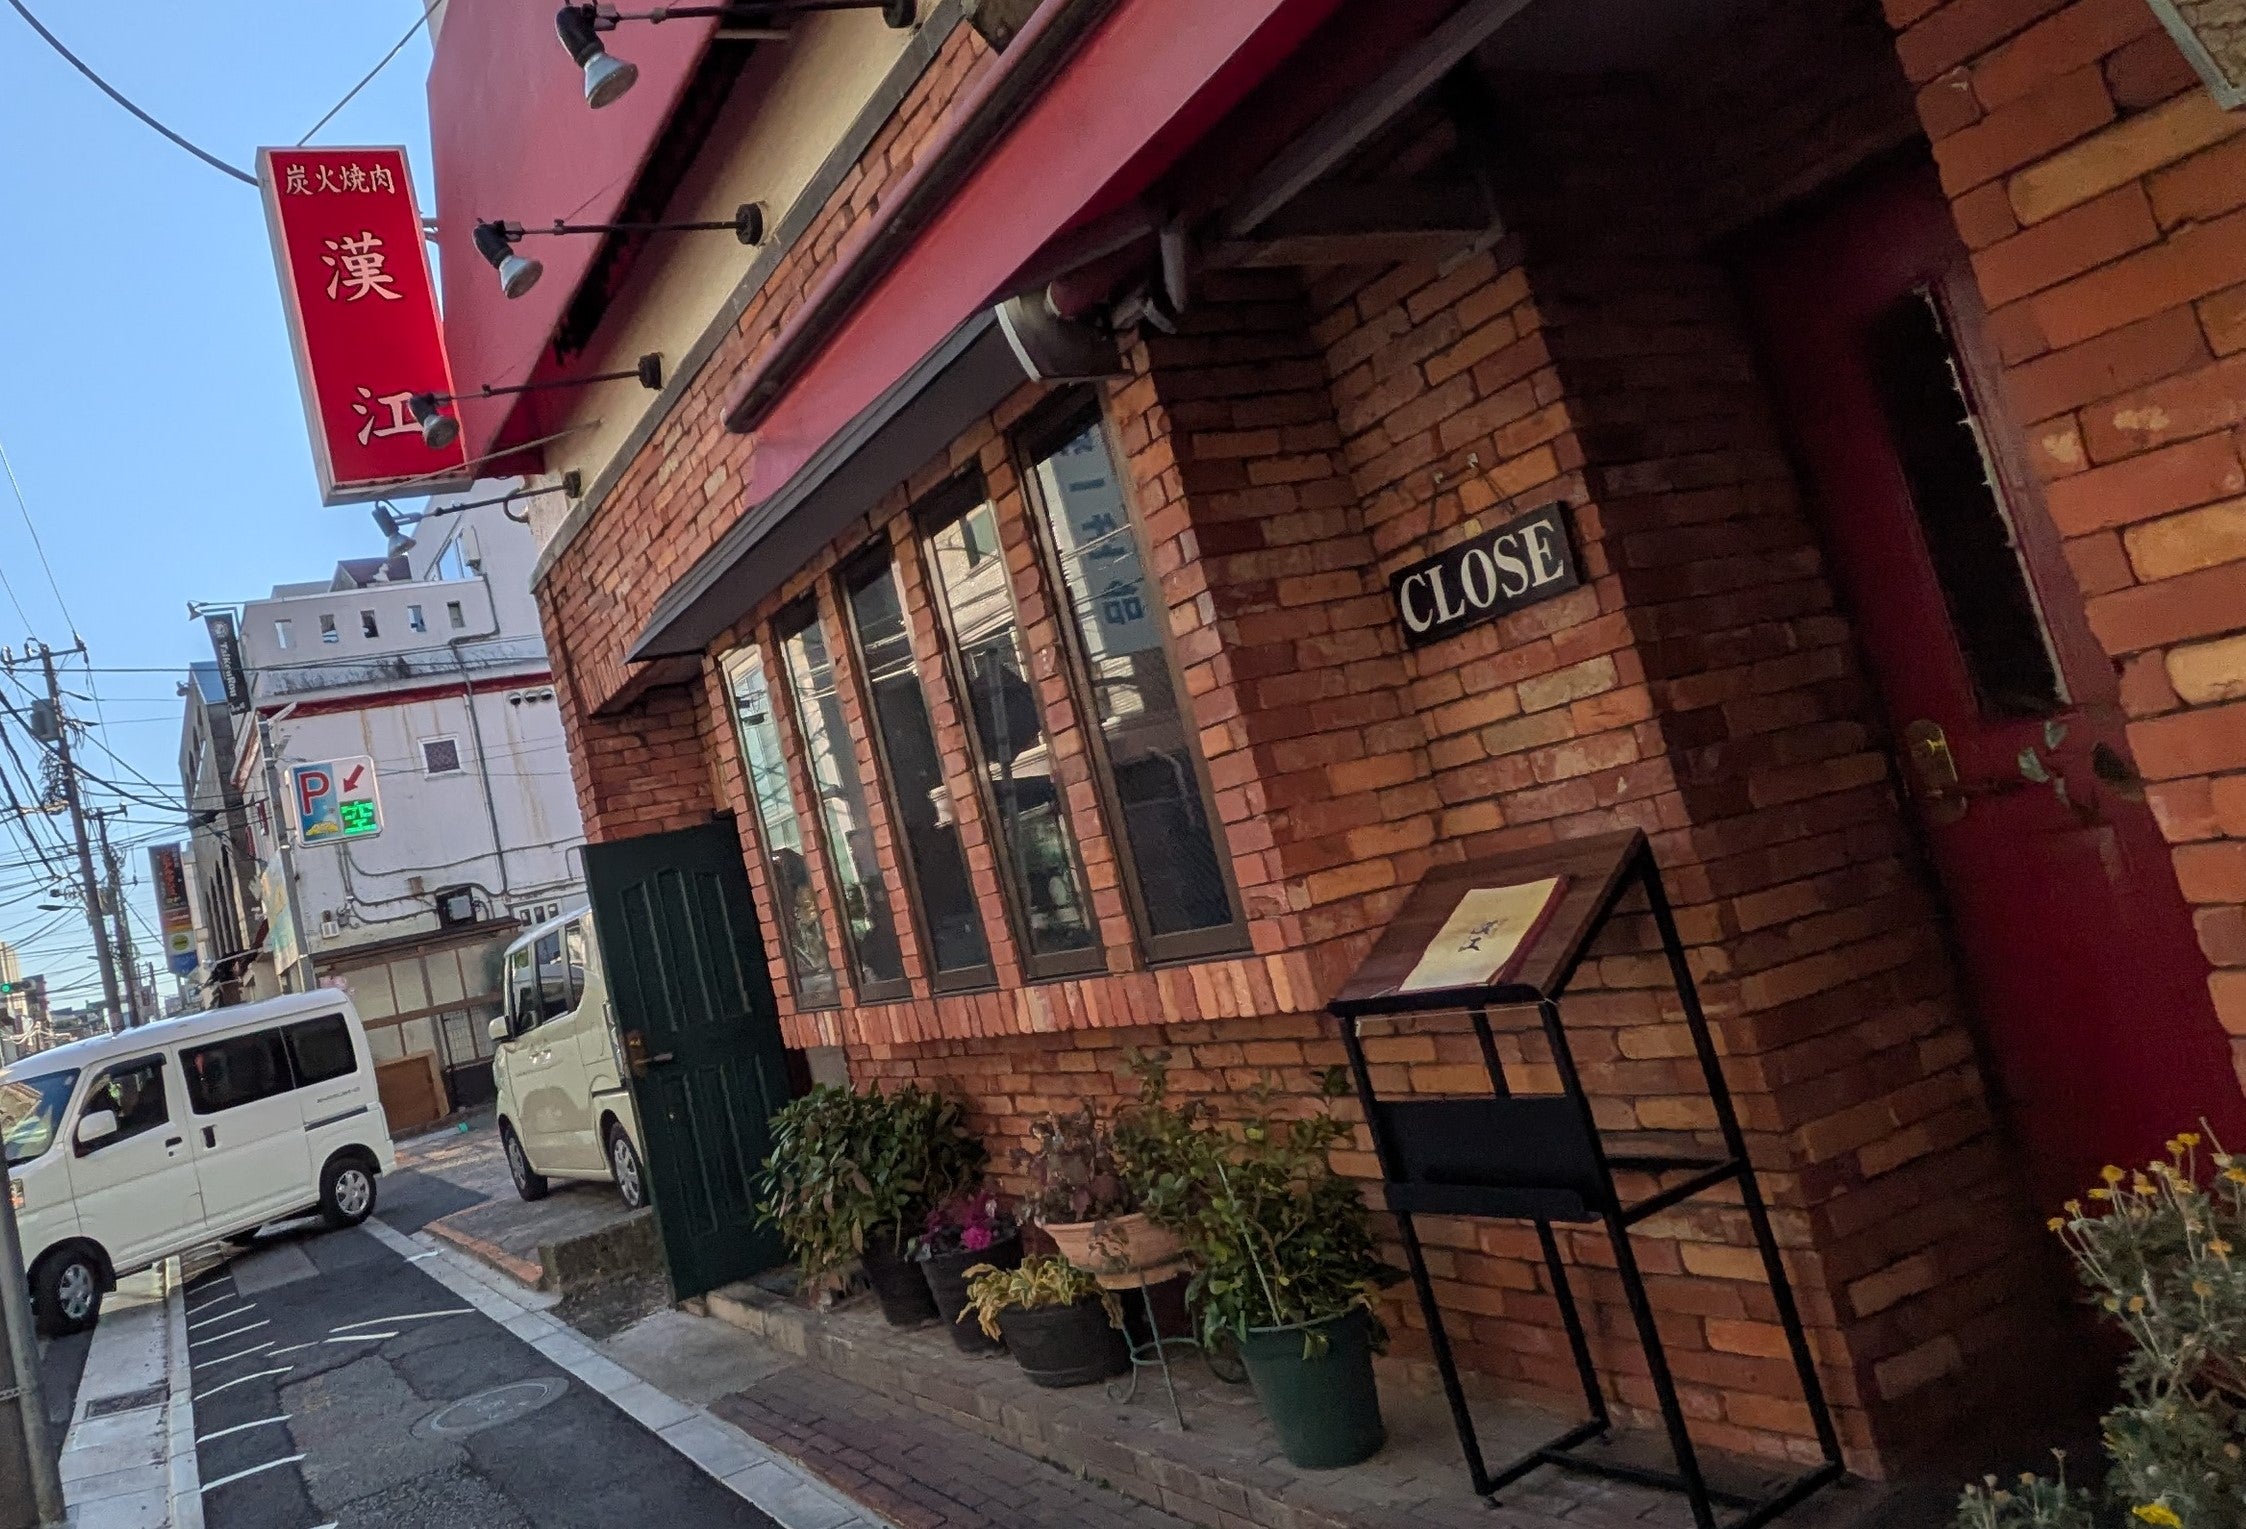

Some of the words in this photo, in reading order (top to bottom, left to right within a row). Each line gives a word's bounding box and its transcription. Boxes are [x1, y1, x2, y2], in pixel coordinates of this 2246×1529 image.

[286, 163, 396, 195] 炭火焼肉
[321, 231, 426, 445] 漢江
[1401, 519, 1564, 632] CLOSE
[299, 771, 330, 815] P
[341, 801, 377, 834] 空
